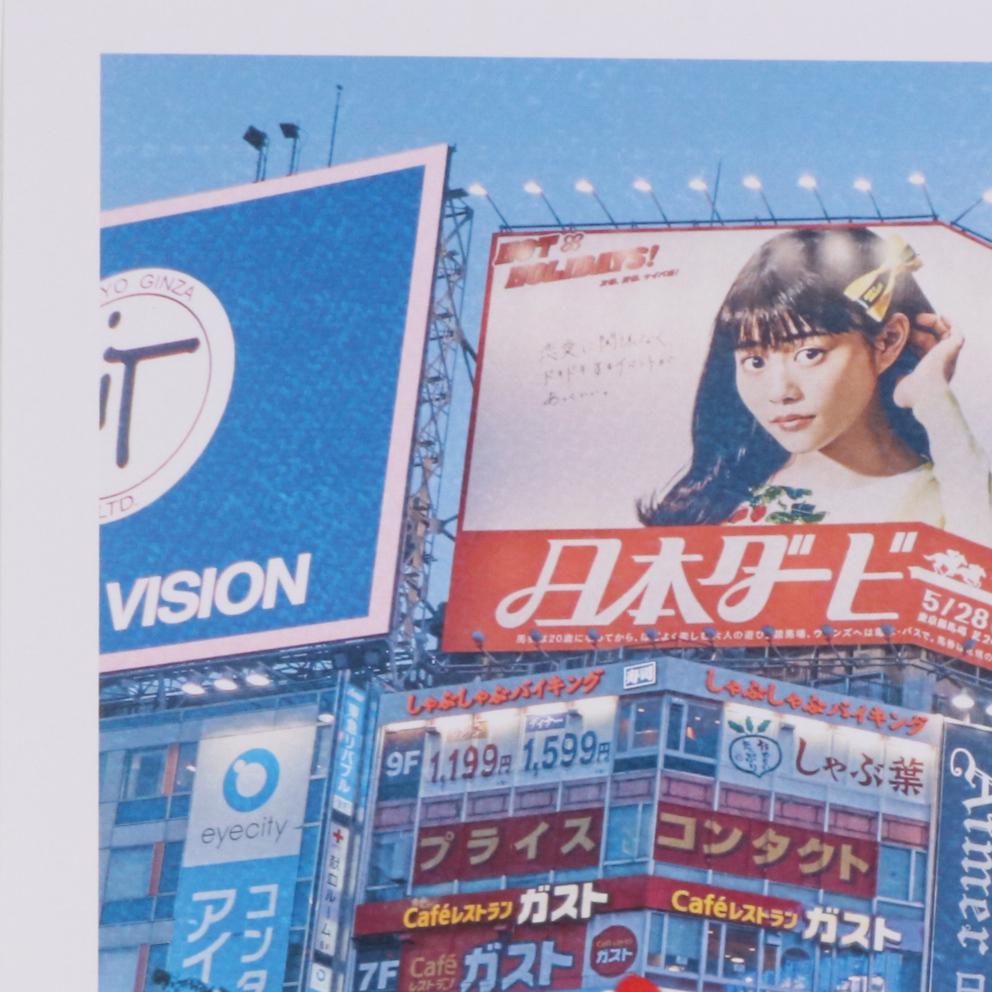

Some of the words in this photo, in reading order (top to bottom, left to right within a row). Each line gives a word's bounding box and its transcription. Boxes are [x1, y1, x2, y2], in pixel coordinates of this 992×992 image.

[139, 273, 195, 300] GINZA
[106, 553, 312, 631] VISION
[406, 668, 605, 716] しゃぶしゃぶバイキング
[705, 667, 928, 737] しゃぶしゃぶバイキング
[386, 750, 421, 776] 9F
[795, 736, 925, 797] しゃぶ葉
[201, 816, 288, 847] eyecity
[420, 816, 596, 872] プライス
[657, 812, 870, 881] コンタクト
[517, 882, 609, 925] ガスト
[802, 906, 902, 952] ガスト
[358, 960, 400, 991] 7F
[410, 953, 458, 979] Café
[595, 947, 634, 964] ガスト
